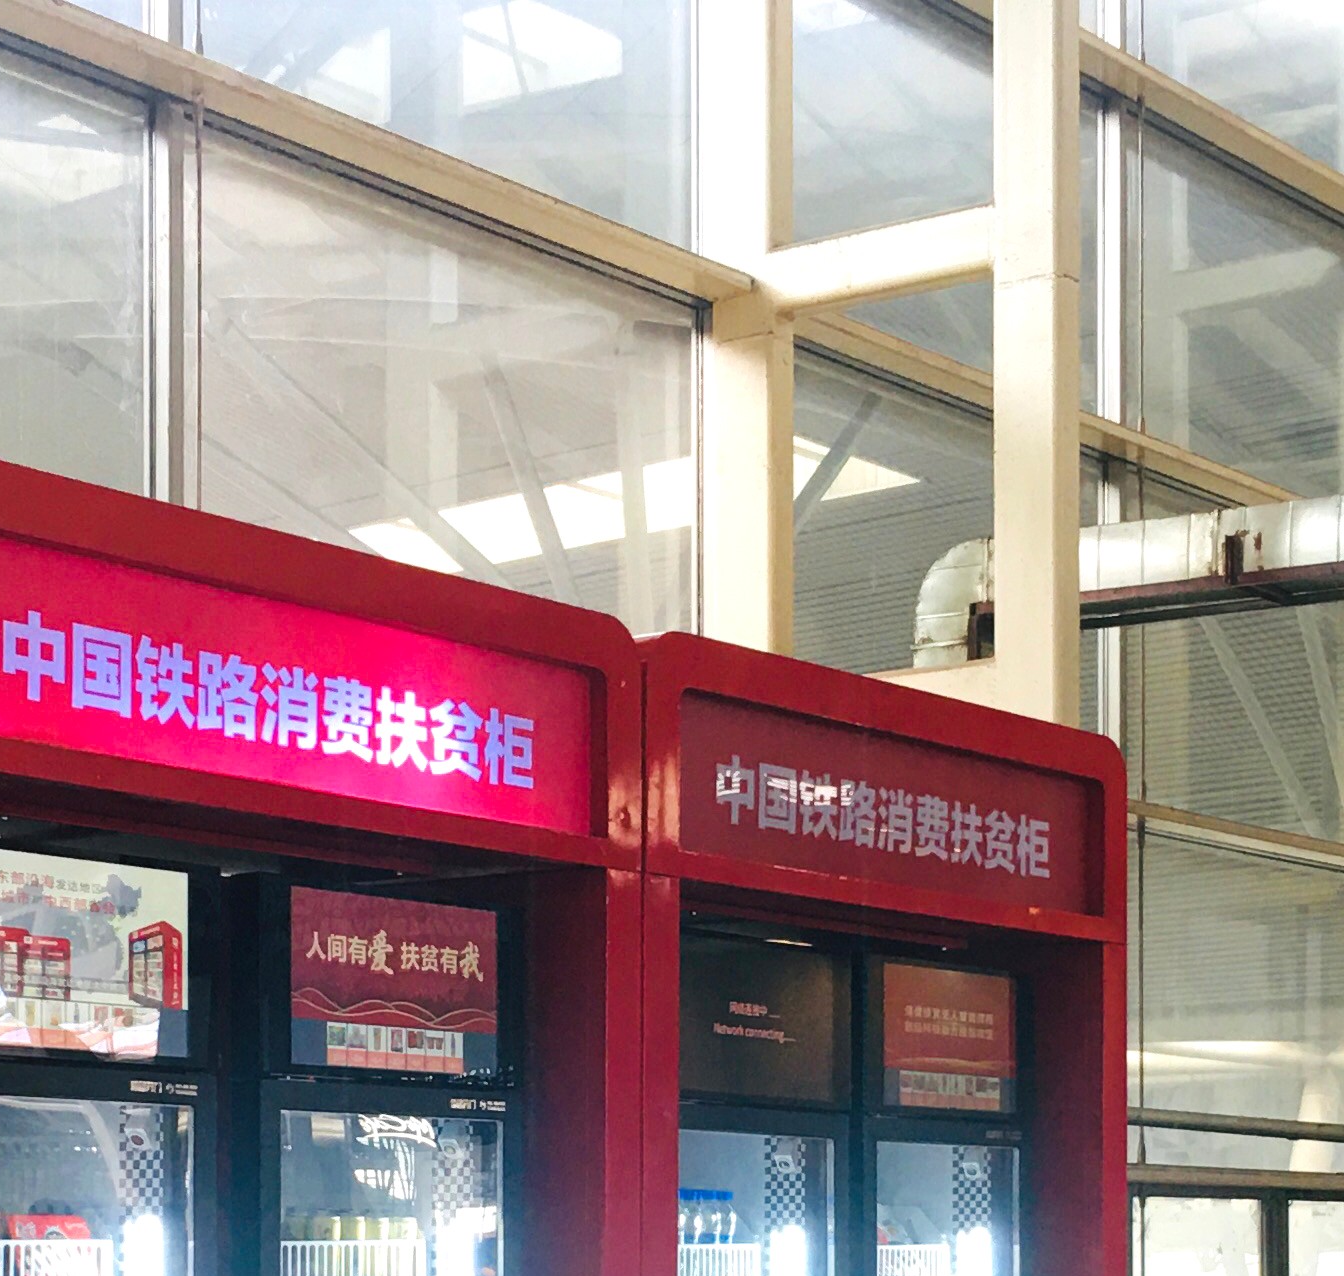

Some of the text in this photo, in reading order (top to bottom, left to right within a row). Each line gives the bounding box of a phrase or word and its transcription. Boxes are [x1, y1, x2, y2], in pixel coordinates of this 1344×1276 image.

[2, 610, 534, 789] 中国铁路消费扶贫柜
[716, 755, 1050, 878] 中国铁路消费扶贫柜
[306, 929, 483, 982] 人间有爱 扶贫有我
